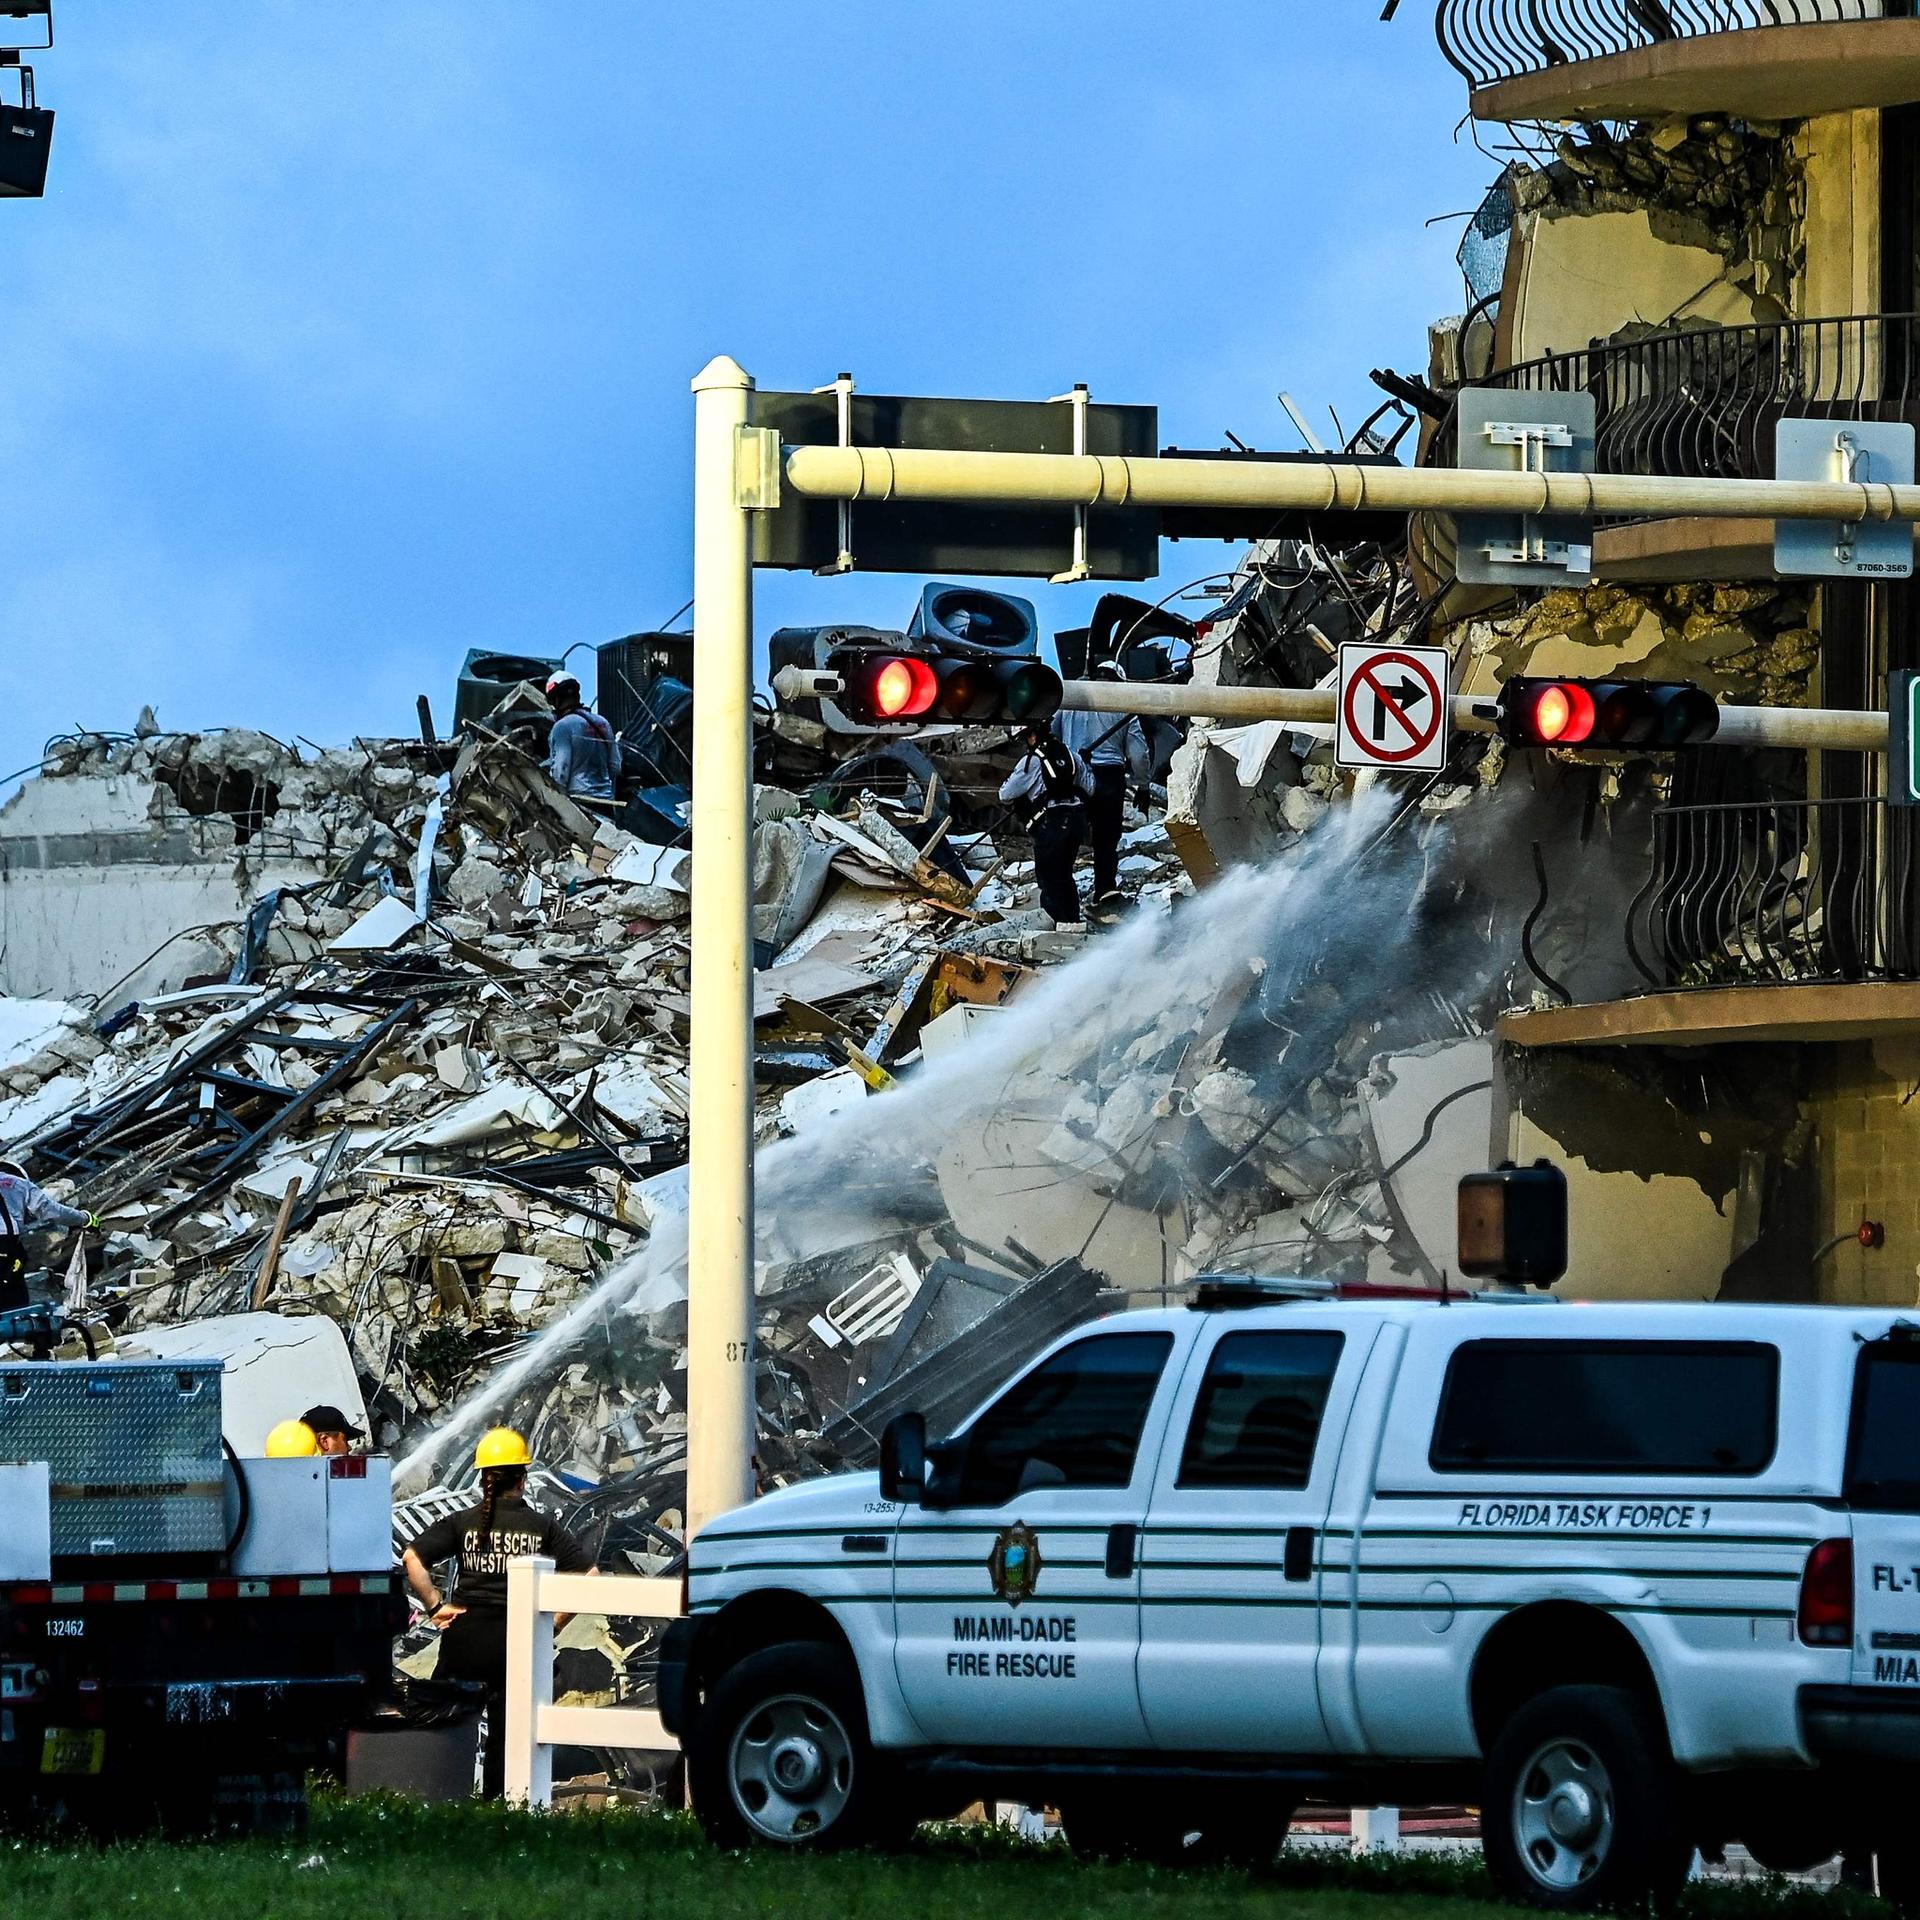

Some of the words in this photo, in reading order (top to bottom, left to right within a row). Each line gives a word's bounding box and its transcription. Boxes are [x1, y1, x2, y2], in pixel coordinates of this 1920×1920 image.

[1857, 564, 1907, 572] 87060-3569
[727, 1342, 752, 1362] 87
[1458, 1504, 1550, 1526] FLORIDA
[1557, 1505, 1611, 1527] TASK
[1616, 1505, 1695, 1528] FORCE
[1701, 1508, 1711, 1528] 1
[464, 1530, 501, 1552] CRE
[463, 1552, 516, 1574] INVESTI
[45, 1620, 84, 1636] 132462
[954, 1617, 1076, 1642] MIAMI-DADE
[947, 1653, 990, 1677] FIRE
[996, 1653, 1076, 1678] RESCUE
